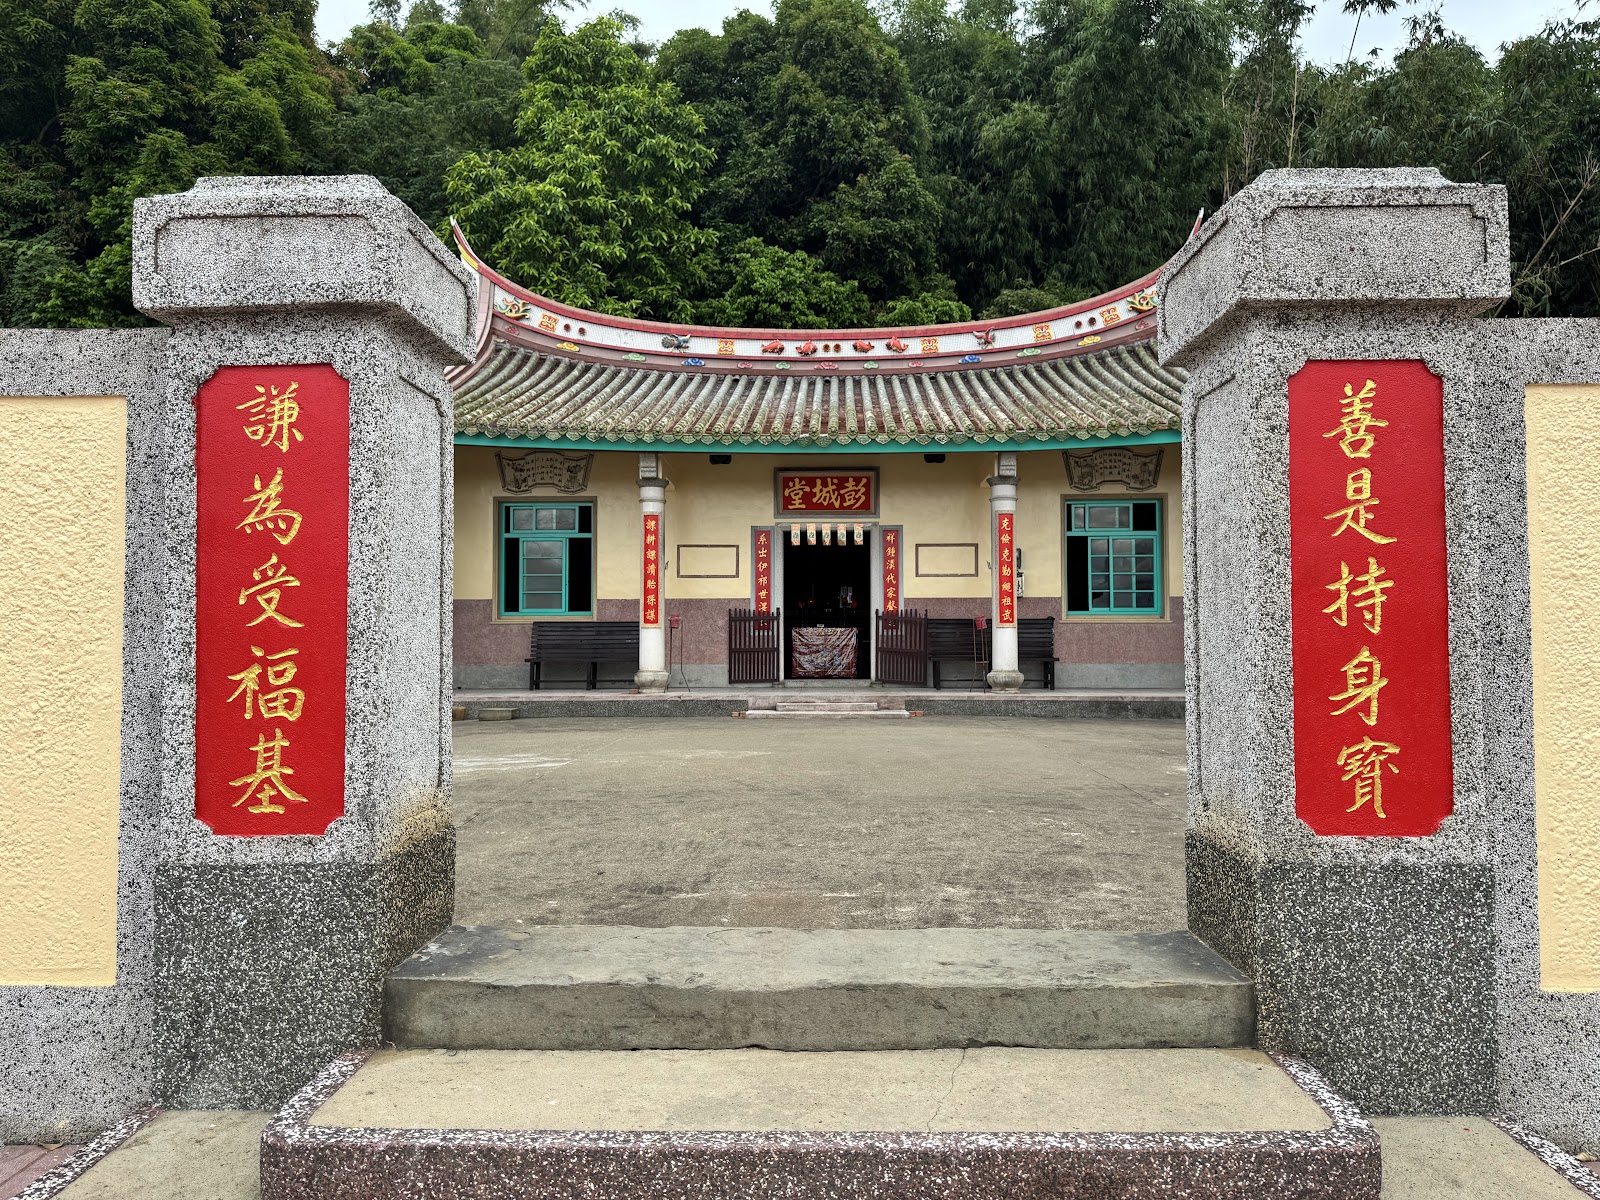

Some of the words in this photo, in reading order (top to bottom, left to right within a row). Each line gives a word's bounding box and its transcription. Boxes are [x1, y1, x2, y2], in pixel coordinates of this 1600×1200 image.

[226, 380, 309, 815] 謙為受福基
[757, 532, 769, 627] 系出伊祁世澤
[784, 477, 868, 509] 彭城堂
[1321, 378, 1401, 819] 善是持身寶
